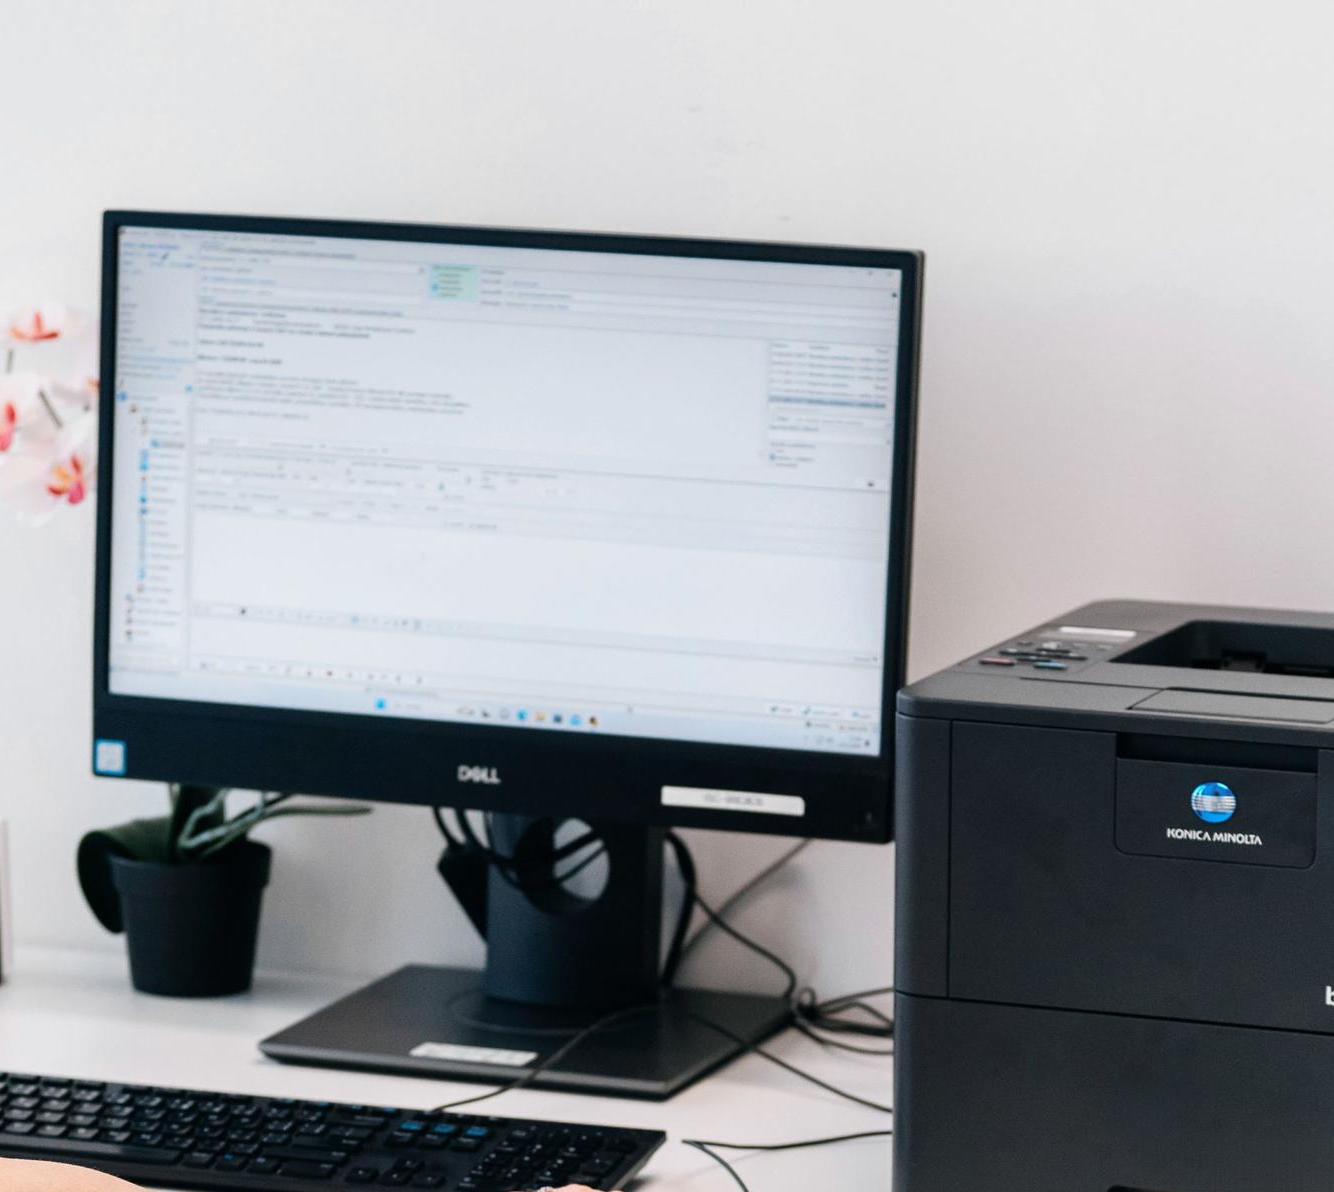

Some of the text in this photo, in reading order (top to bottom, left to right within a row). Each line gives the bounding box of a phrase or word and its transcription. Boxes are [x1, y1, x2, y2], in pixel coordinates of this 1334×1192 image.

[457, 764, 501, 785] DELL
[1166, 827, 1263, 846] KONICA MINOLTA
